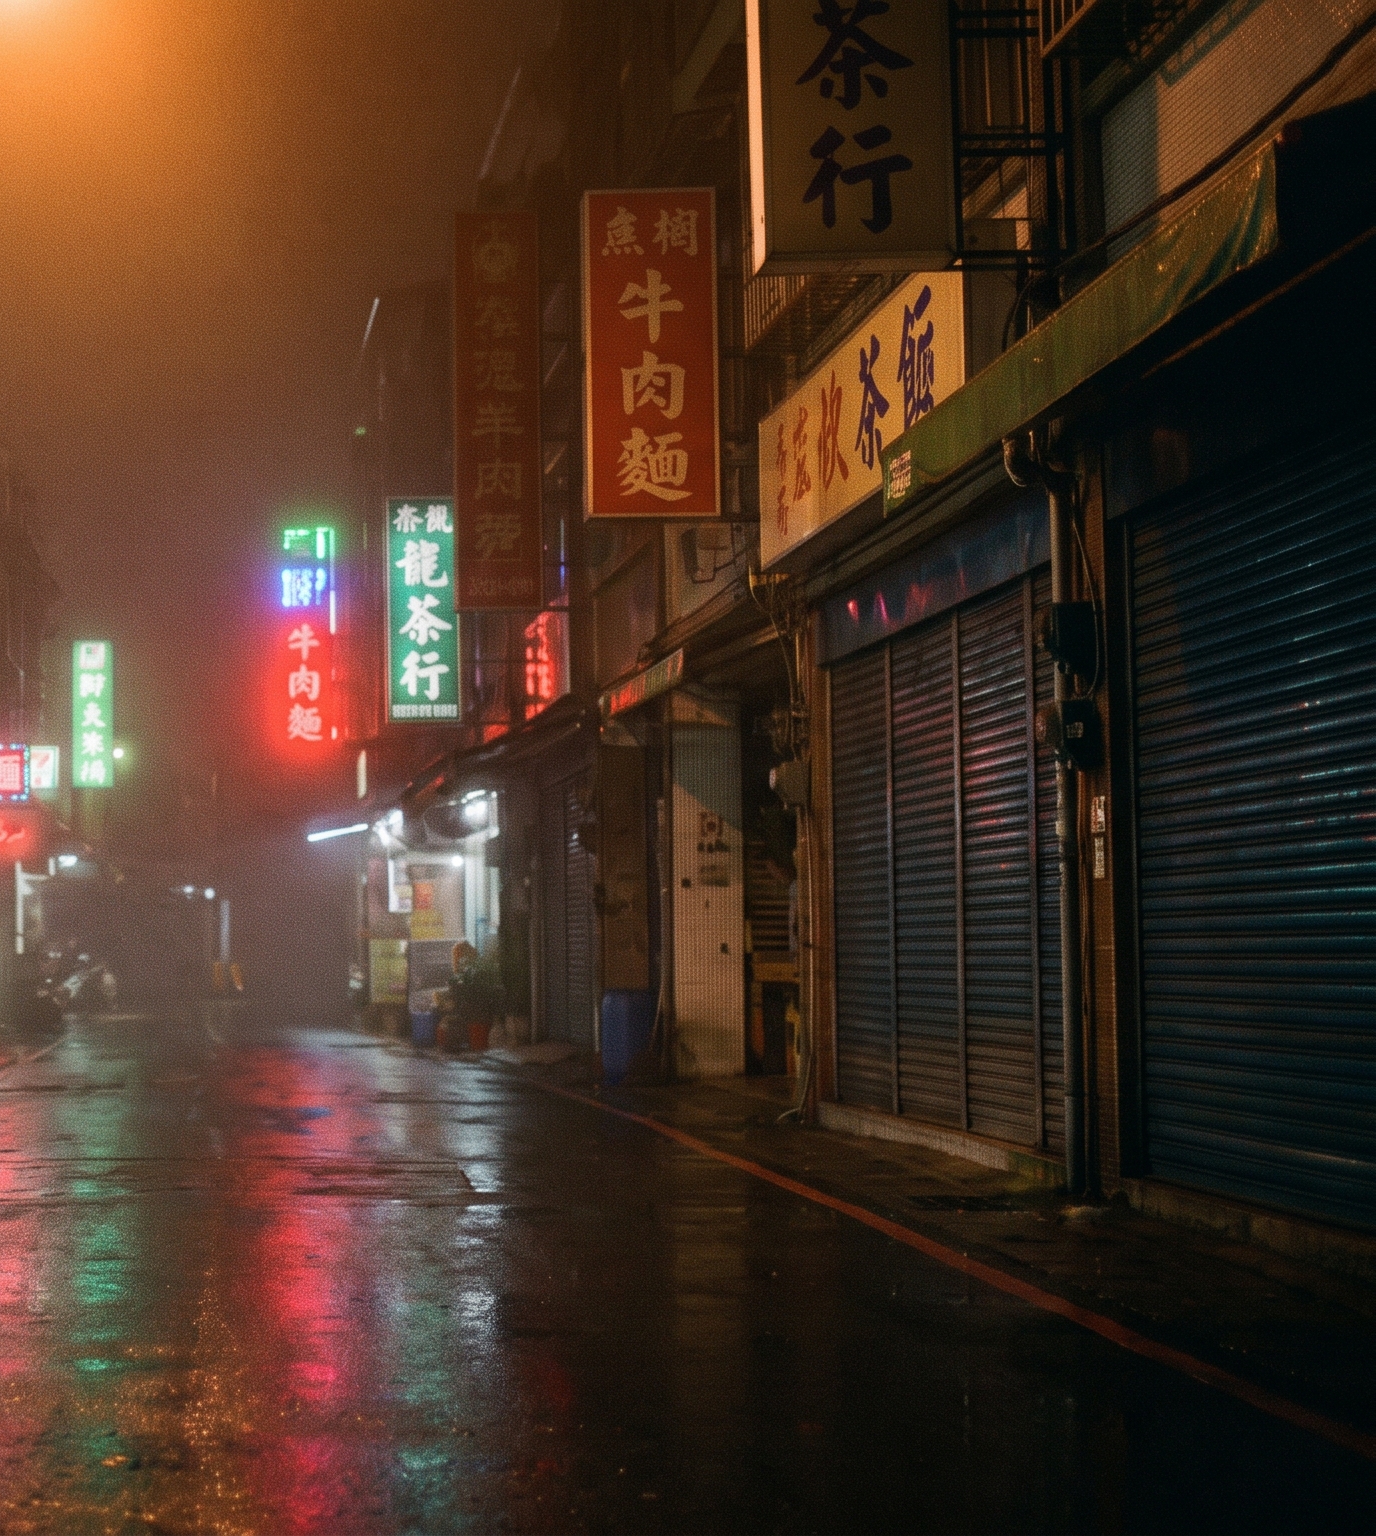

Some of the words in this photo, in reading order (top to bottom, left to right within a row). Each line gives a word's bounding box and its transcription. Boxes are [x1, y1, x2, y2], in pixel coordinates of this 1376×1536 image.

[795, 0, 913, 234] 茶行
[617, 268, 693, 502] 牛肉麵
[287, 622, 324, 742] 牛肉麵
[395, 539, 453, 701] 龍茶行
